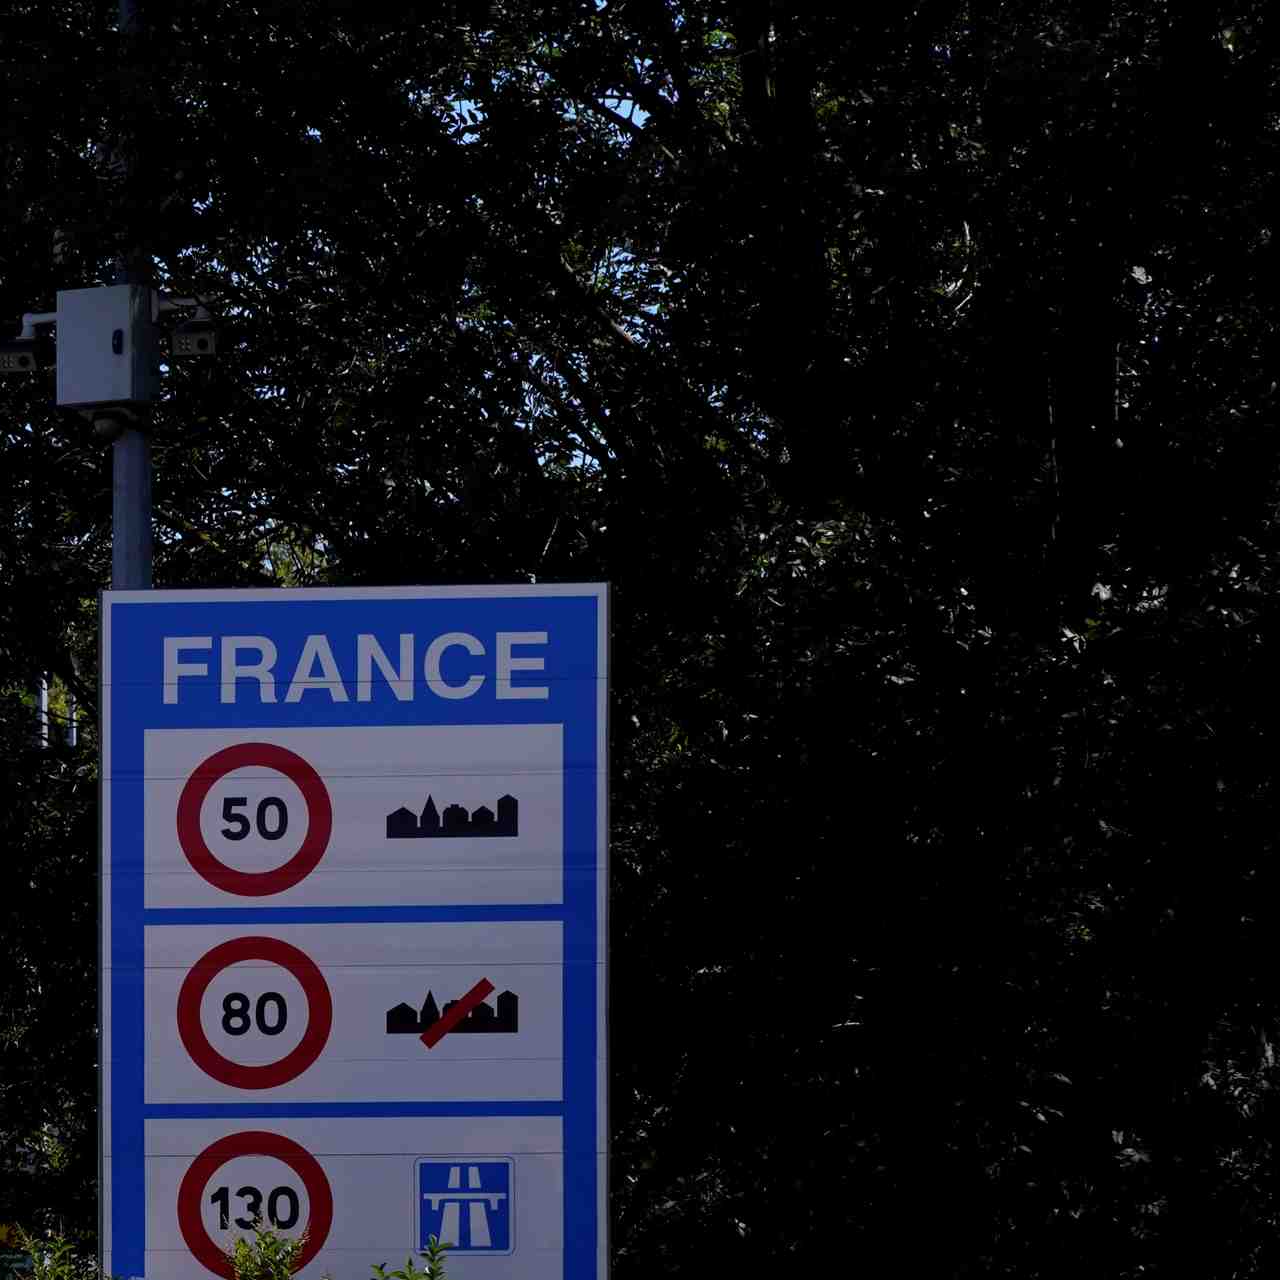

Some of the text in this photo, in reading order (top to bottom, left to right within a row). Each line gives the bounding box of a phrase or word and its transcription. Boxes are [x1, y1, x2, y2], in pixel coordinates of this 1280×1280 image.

[162, 631, 550, 705] FRANCE
[220, 796, 289, 841] 50
[220, 991, 289, 1036] 80
[210, 1186, 300, 1231] 130
